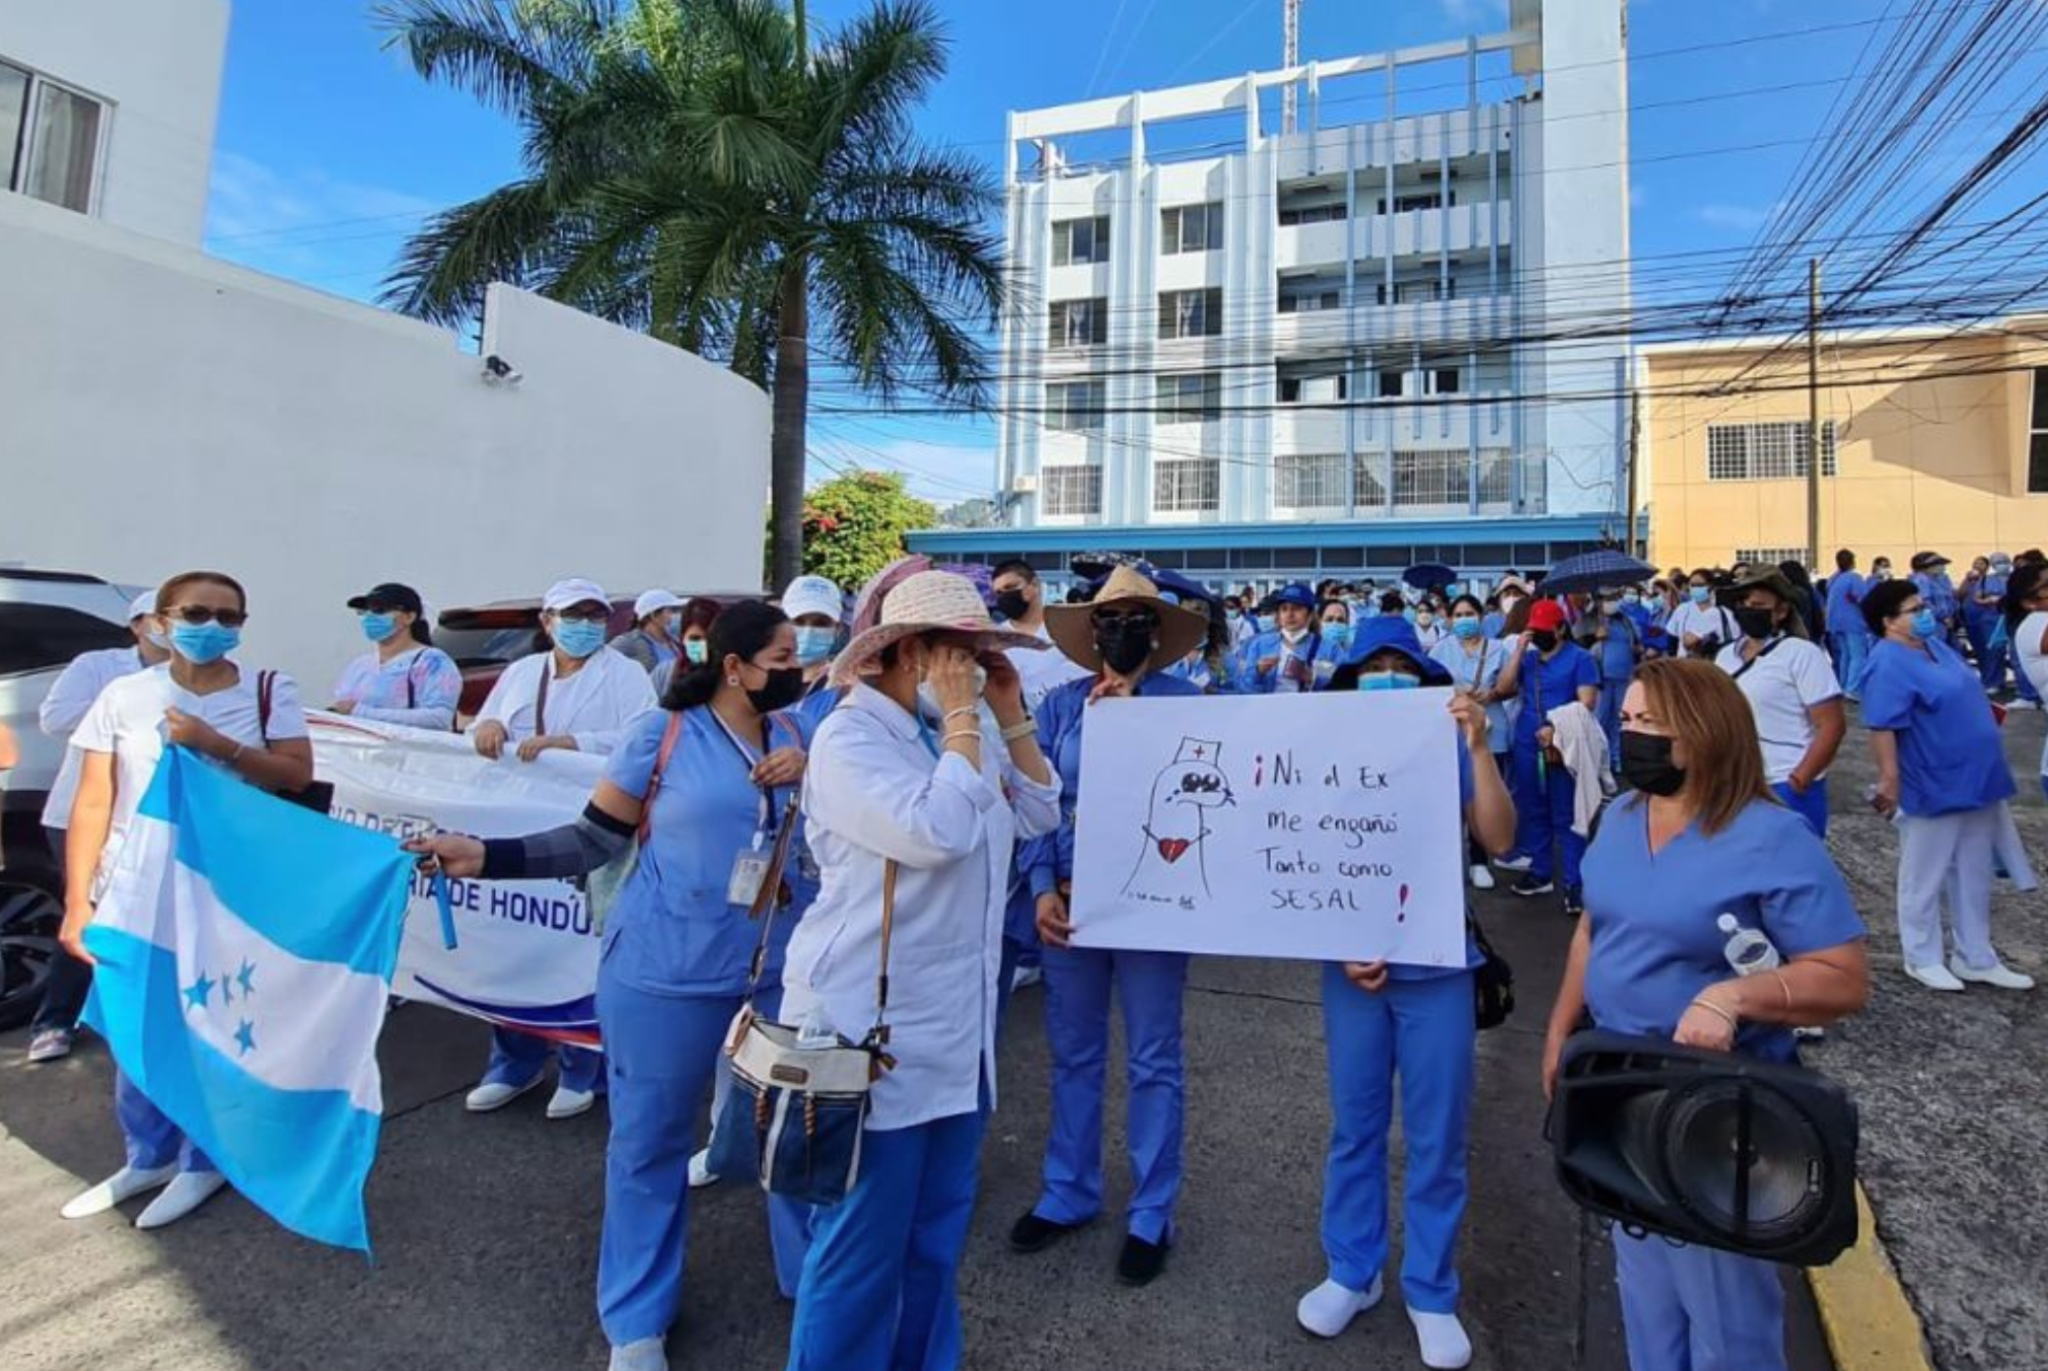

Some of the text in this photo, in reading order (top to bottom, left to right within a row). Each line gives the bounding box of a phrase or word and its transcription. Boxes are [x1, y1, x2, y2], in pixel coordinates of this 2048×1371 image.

[1358, 766, 1389, 789] Ex
[1339, 862, 1393, 879] como
[449, 878, 480, 912] DE
[1270, 888, 1361, 911] SESAL
